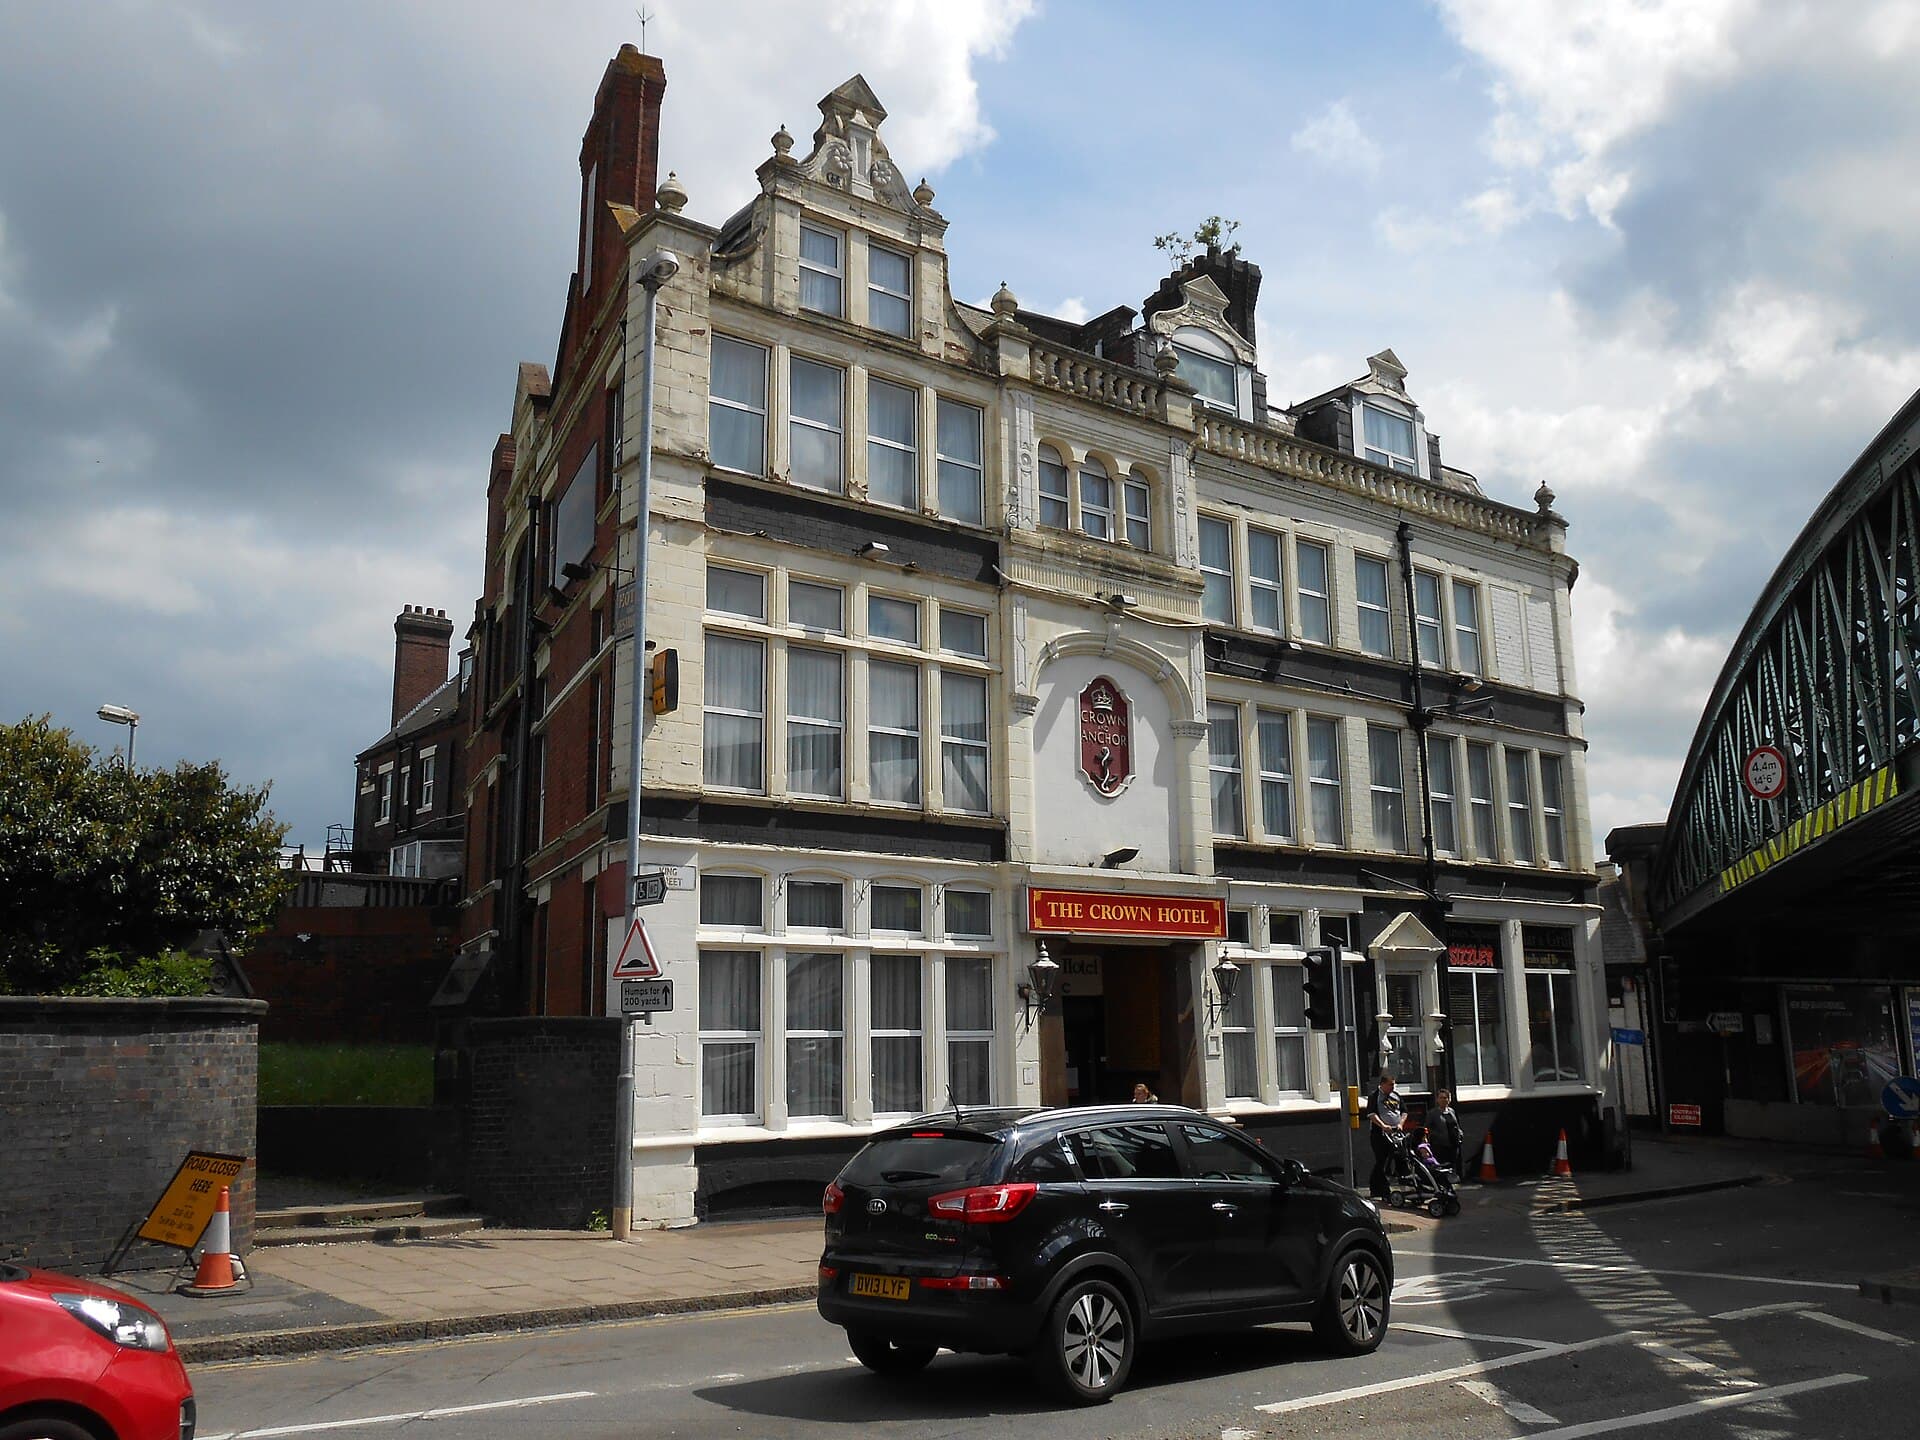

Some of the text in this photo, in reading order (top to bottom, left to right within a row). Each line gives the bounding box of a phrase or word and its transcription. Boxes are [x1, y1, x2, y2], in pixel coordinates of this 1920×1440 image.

[1081, 710, 1126, 727] CROWN
[1081, 730, 1127, 746] ANCHOR
[1752, 761, 1777, 772] 4.4m
[1047, 901, 1209, 924] THE CROWN HOTEL
[1448, 944, 1494, 967] SIZZLER
[625, 986, 660, 996] Humps for
[625, 997, 660, 1007] 200 yards
[186, 1157, 241, 1176] ROAD CLOSED
[190, 1179, 213, 1193] HERE
[857, 1276, 906, 1296] DV13 LYF
